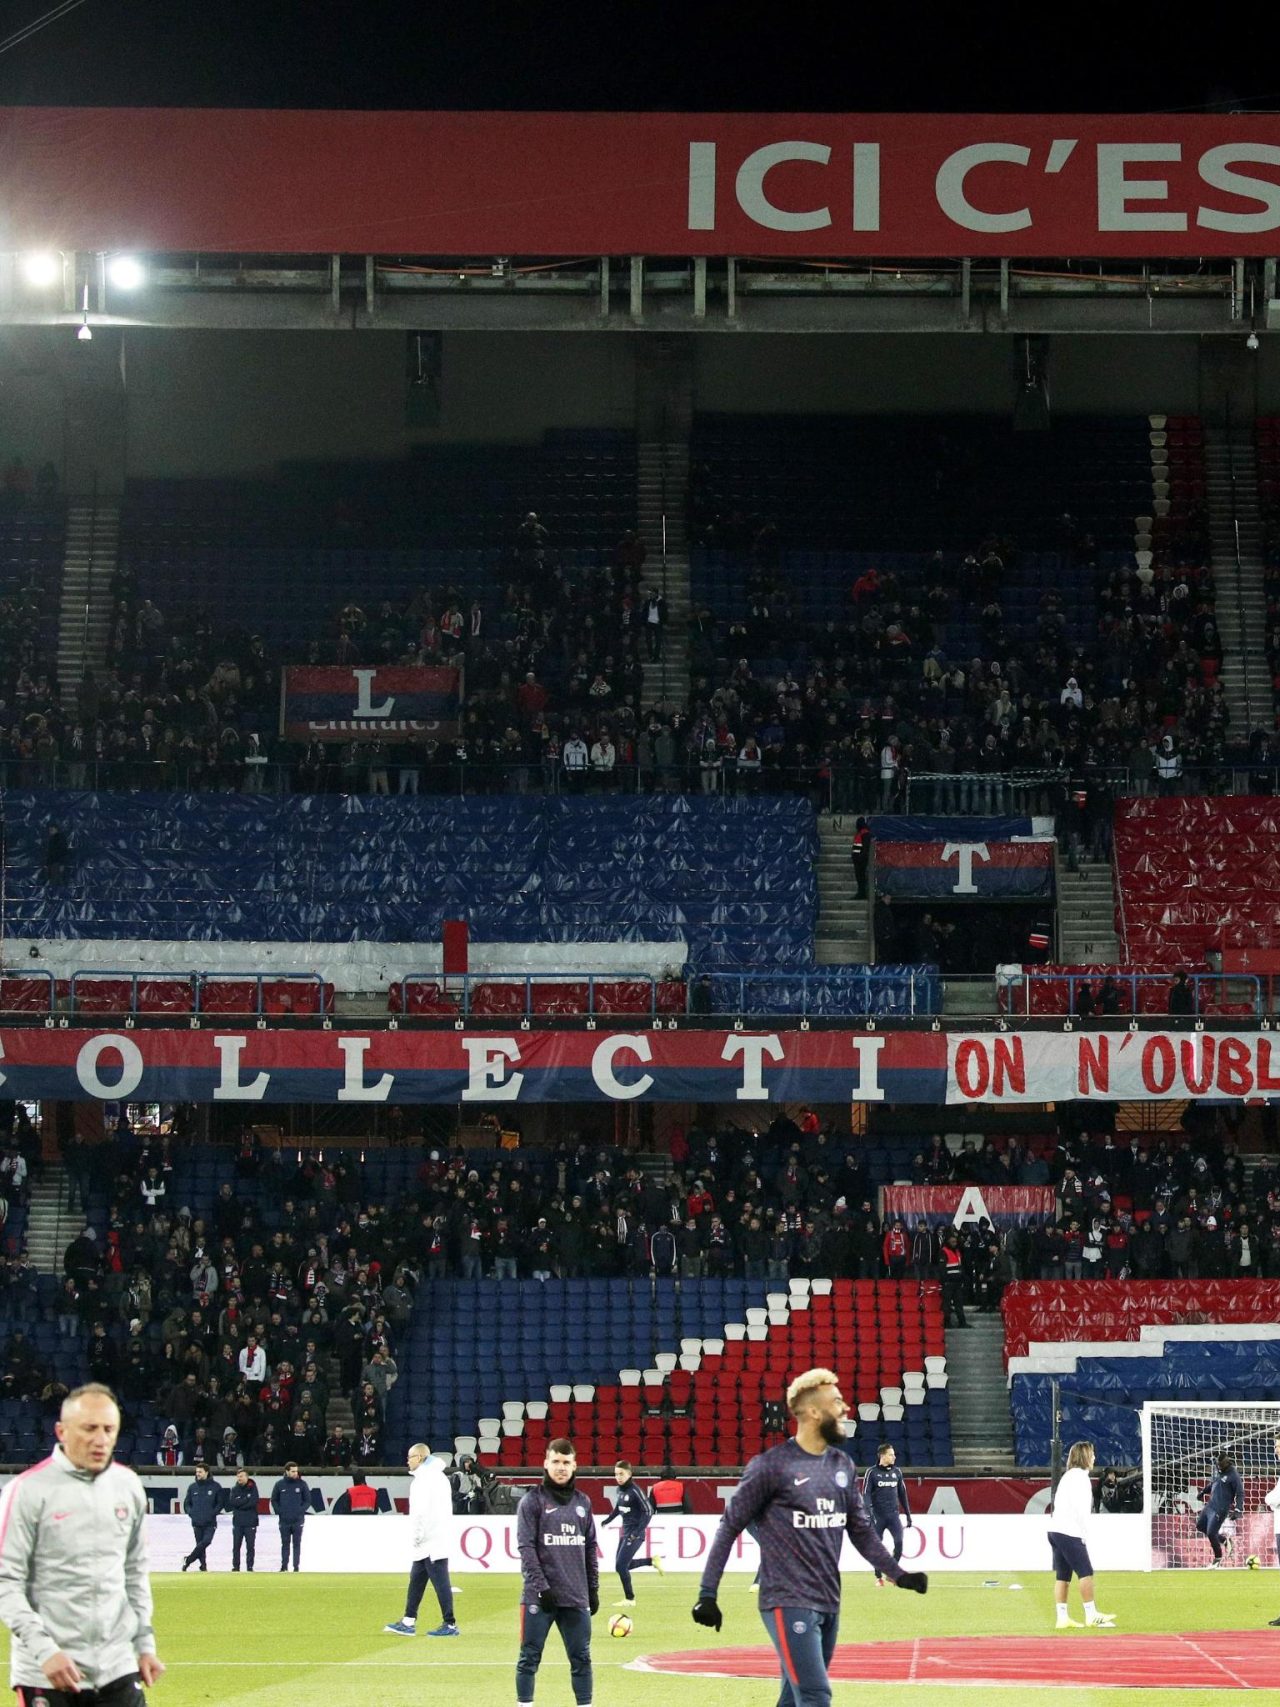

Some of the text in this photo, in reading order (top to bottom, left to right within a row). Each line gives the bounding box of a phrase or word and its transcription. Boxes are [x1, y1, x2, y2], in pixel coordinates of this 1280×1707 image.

[688, 141, 880, 232] ICI
[353, 669, 396, 717] L
[940, 842, 991, 894] T
[0, 1033, 885, 1101] OLLECTI
[954, 1035, 1026, 1098] ON
[952, 1186, 996, 1234] A
[816, 1497, 835, 1512] Fly
[543, 1533, 587, 1546] Emirate
[561, 1523, 576, 1535] Fly
